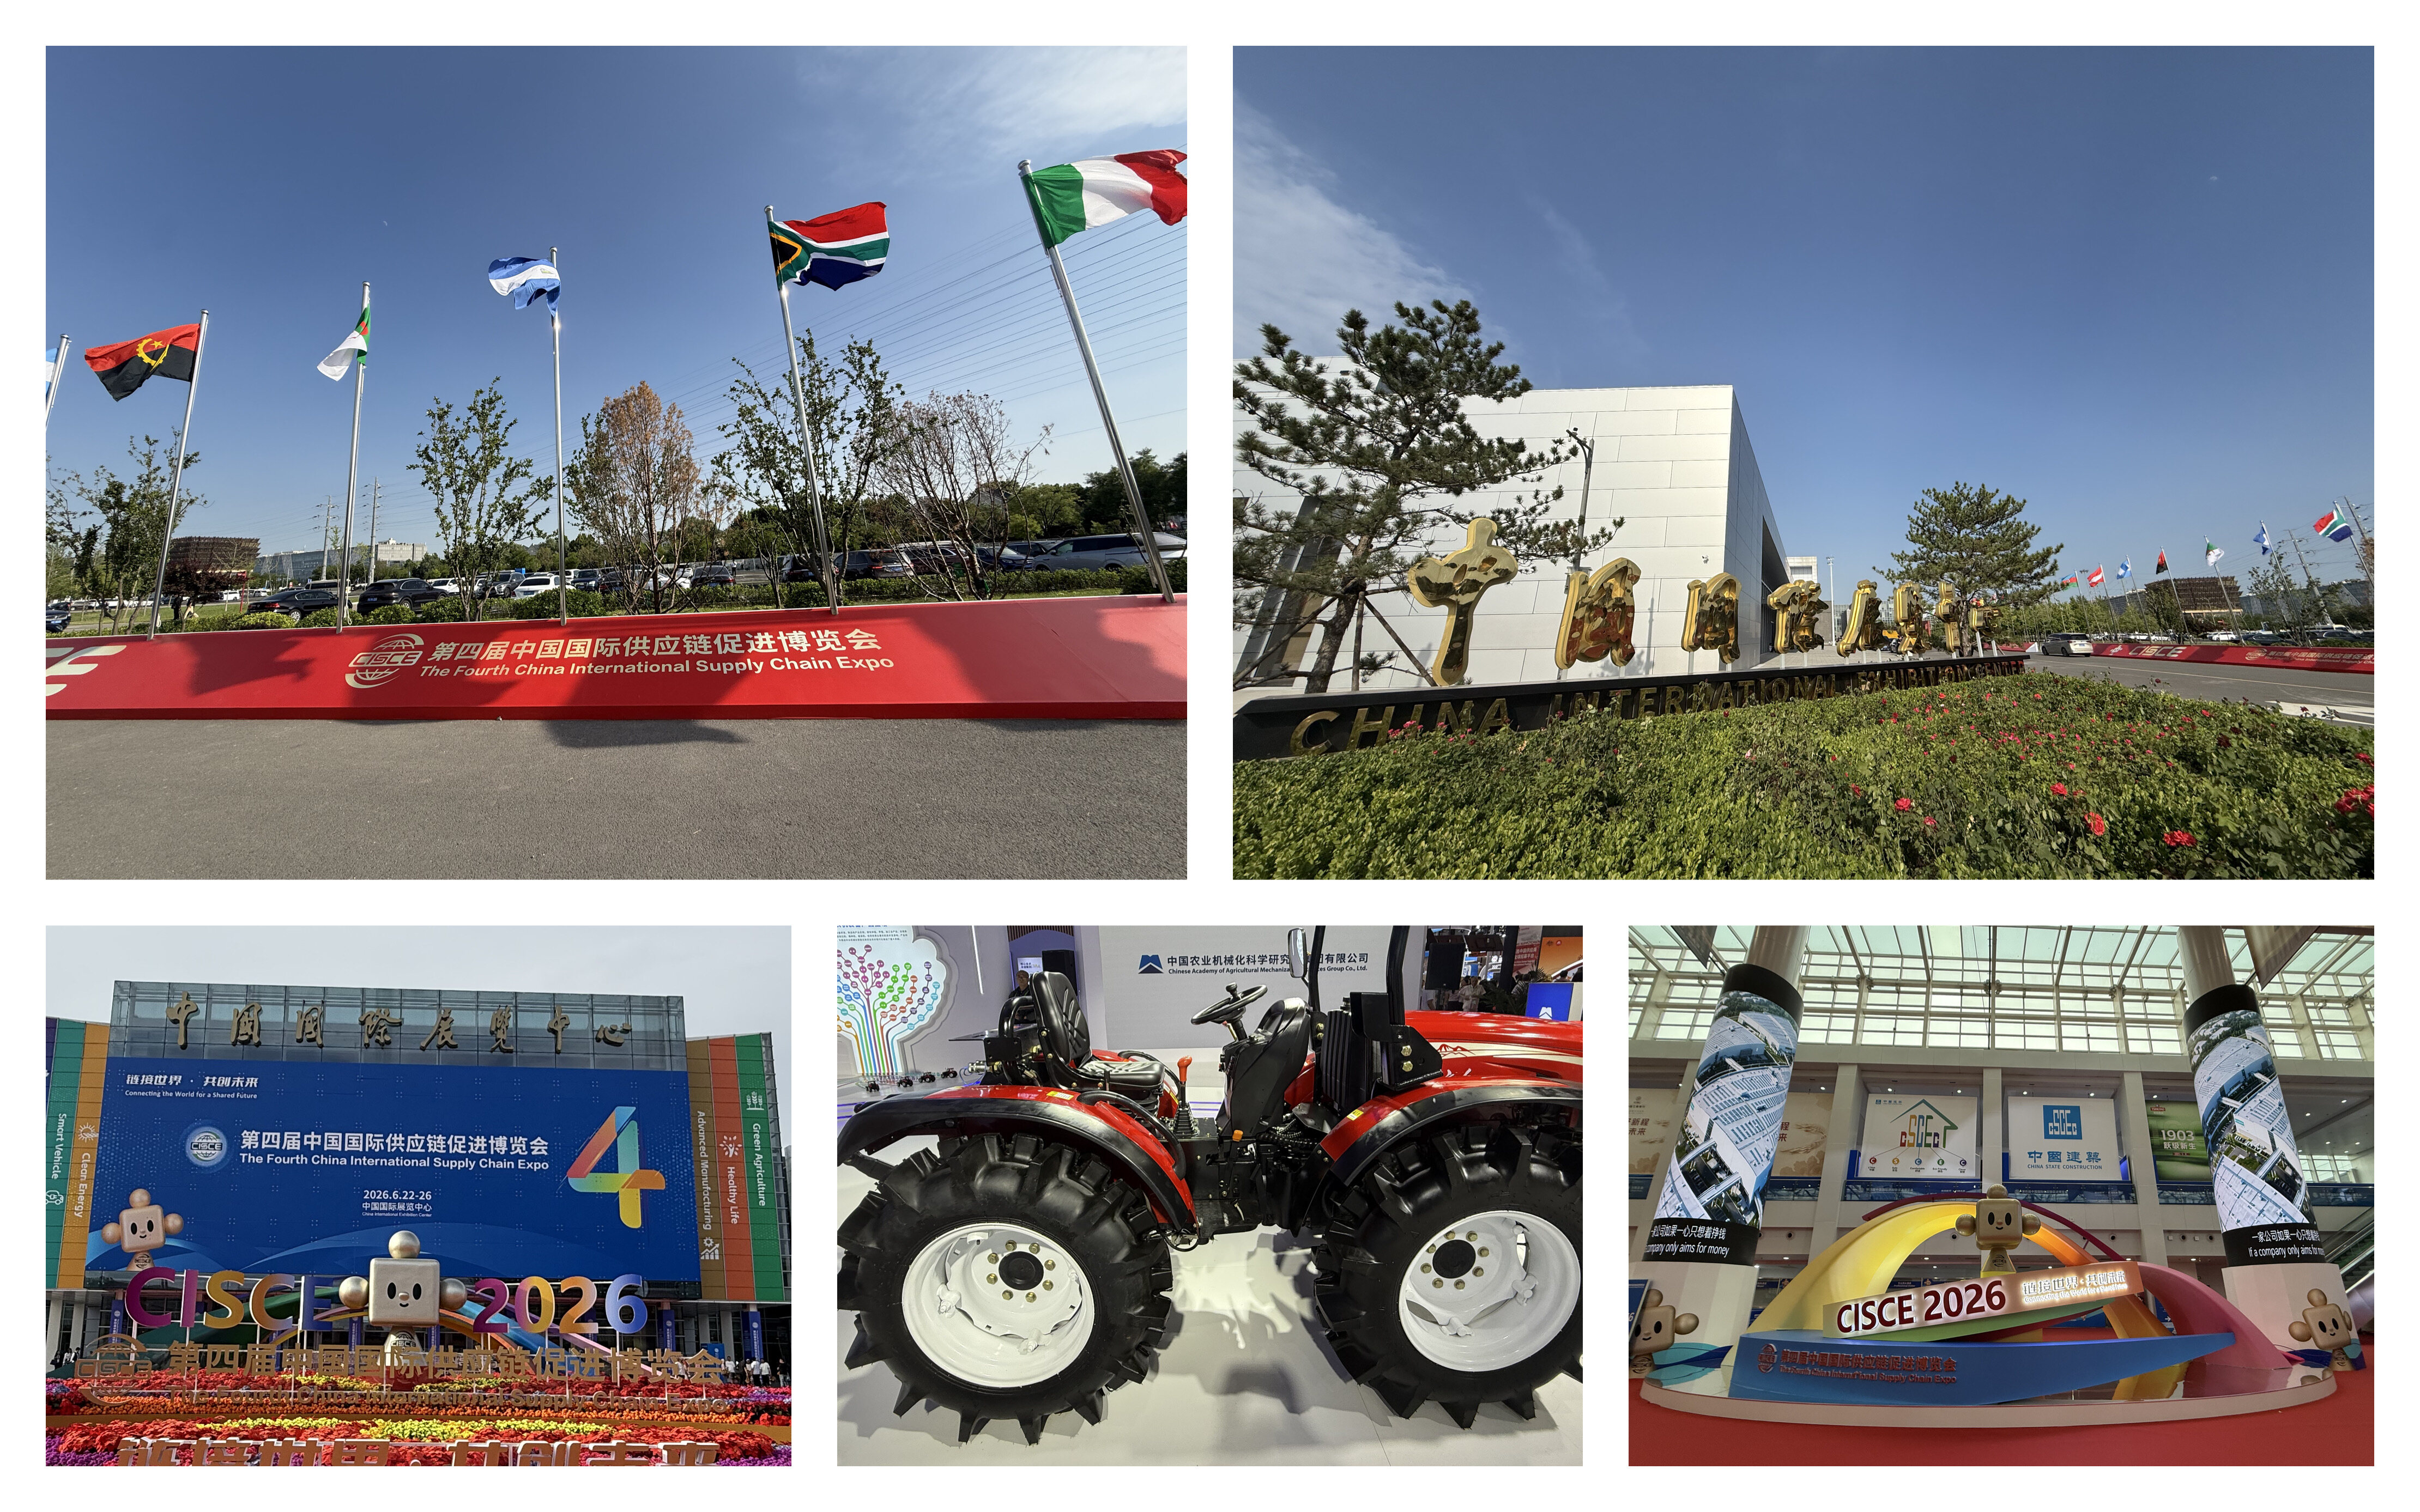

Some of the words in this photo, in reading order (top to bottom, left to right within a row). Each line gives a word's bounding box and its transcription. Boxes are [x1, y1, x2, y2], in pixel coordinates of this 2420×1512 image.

[428, 629, 882, 661] 第四届中国国际供应链促进博览会
[2128, 646, 2187, 657] CISCE
[352, 652, 420, 666] CISCE
[420, 666, 450, 677] The
[453, 664, 510, 677] Fourth
[515, 663, 565, 676] China
[570, 660, 689, 674] International
[696, 658, 764, 674] Supply
[770, 657, 832, 670] Chain
[836, 656, 894, 671] Expo
[56, 1113, 66, 1141] Smart
[697, 1110, 709, 1158] Advanced
[753, 1123, 761, 1151] Green
[2161, 1130, 2194, 1141] 1903
[191, 1142, 222, 1150] CISCE
[241, 1130, 548, 1156] 第四届中国国际供应链促进博览会
[2163, 1141, 2197, 1150] 跃级新生
[51, 1143, 64, 1180] Vehicle
[80, 1152, 90, 1181] Clean
[239, 1153, 263, 1163] The
[267, 1154, 308, 1164] Fourth
[311, 1155, 347, 1165] China
[350, 1155, 429, 1167] International
[433, 1157, 476, 1170] Supply
[479, 1158, 514, 1169] Chain
[518, 1159, 549, 1171] Expo
[567, 1106, 666, 1228] 4
[727, 1167, 738, 1204] Healthy
[753, 1153, 766, 1206] Agriculture
[74, 1182, 88, 1218] Energy
[362, 1201, 432, 1212] 中国国际展览中心
[363, 1190, 432, 1200] 2026.6.22-26
[700, 1160, 713, 1230] Manufacturing
[730, 1206, 740, 1225] Life
[1665, 1241, 1679, 1255] only
[1679, 1242, 1695, 1253] aims
[1696, 1242, 1707, 1254] for
[1707, 1245, 1729, 1258] money
[2248, 1247, 2253, 1258] If
[2254, 1249, 2258, 1257] a
[2259, 1247, 2286, 1259] company
[2287, 1244, 2300, 1258] only
[2300, 1244, 2312, 1255] aims
[125, 1267, 334, 1331] CISCE
[473, 1274, 648, 1334] 2026
[1837, 1294, 1916, 1333] CISCE
[1923, 1280, 2006, 1321] 2026
[2024, 1292, 2060, 1303] Connecting
[2071, 1288, 2088, 1296] World
[76, 1362, 149, 1377] CISCE
[167, 1340, 723, 1384] 第四届中国国际供应链促进博览会
[1781, 1349, 1957, 1372] 第四届中国国际供应链促进博览会
[1779, 1365, 1790, 1373] The
[1790, 1366, 1810, 1376] Fourth
[1811, 1368, 1830, 1377] China
[1830, 1369, 1877, 1381] International
[1879, 1373, 1907, 1385] Supply
[1908, 1374, 1933, 1383] Chain
[1934, 1375, 1957, 1385] Expo
[166, 1385, 209, 1404] The
[219, 1386, 289, 1404] Fourth
[296, 1386, 358, 1405] China
[366, 1388, 503, 1406] International
[510, 1389, 586, 1411] Supply
[593, 1390, 658, 1410] Chain
[667, 1393, 728, 1414] Expo
